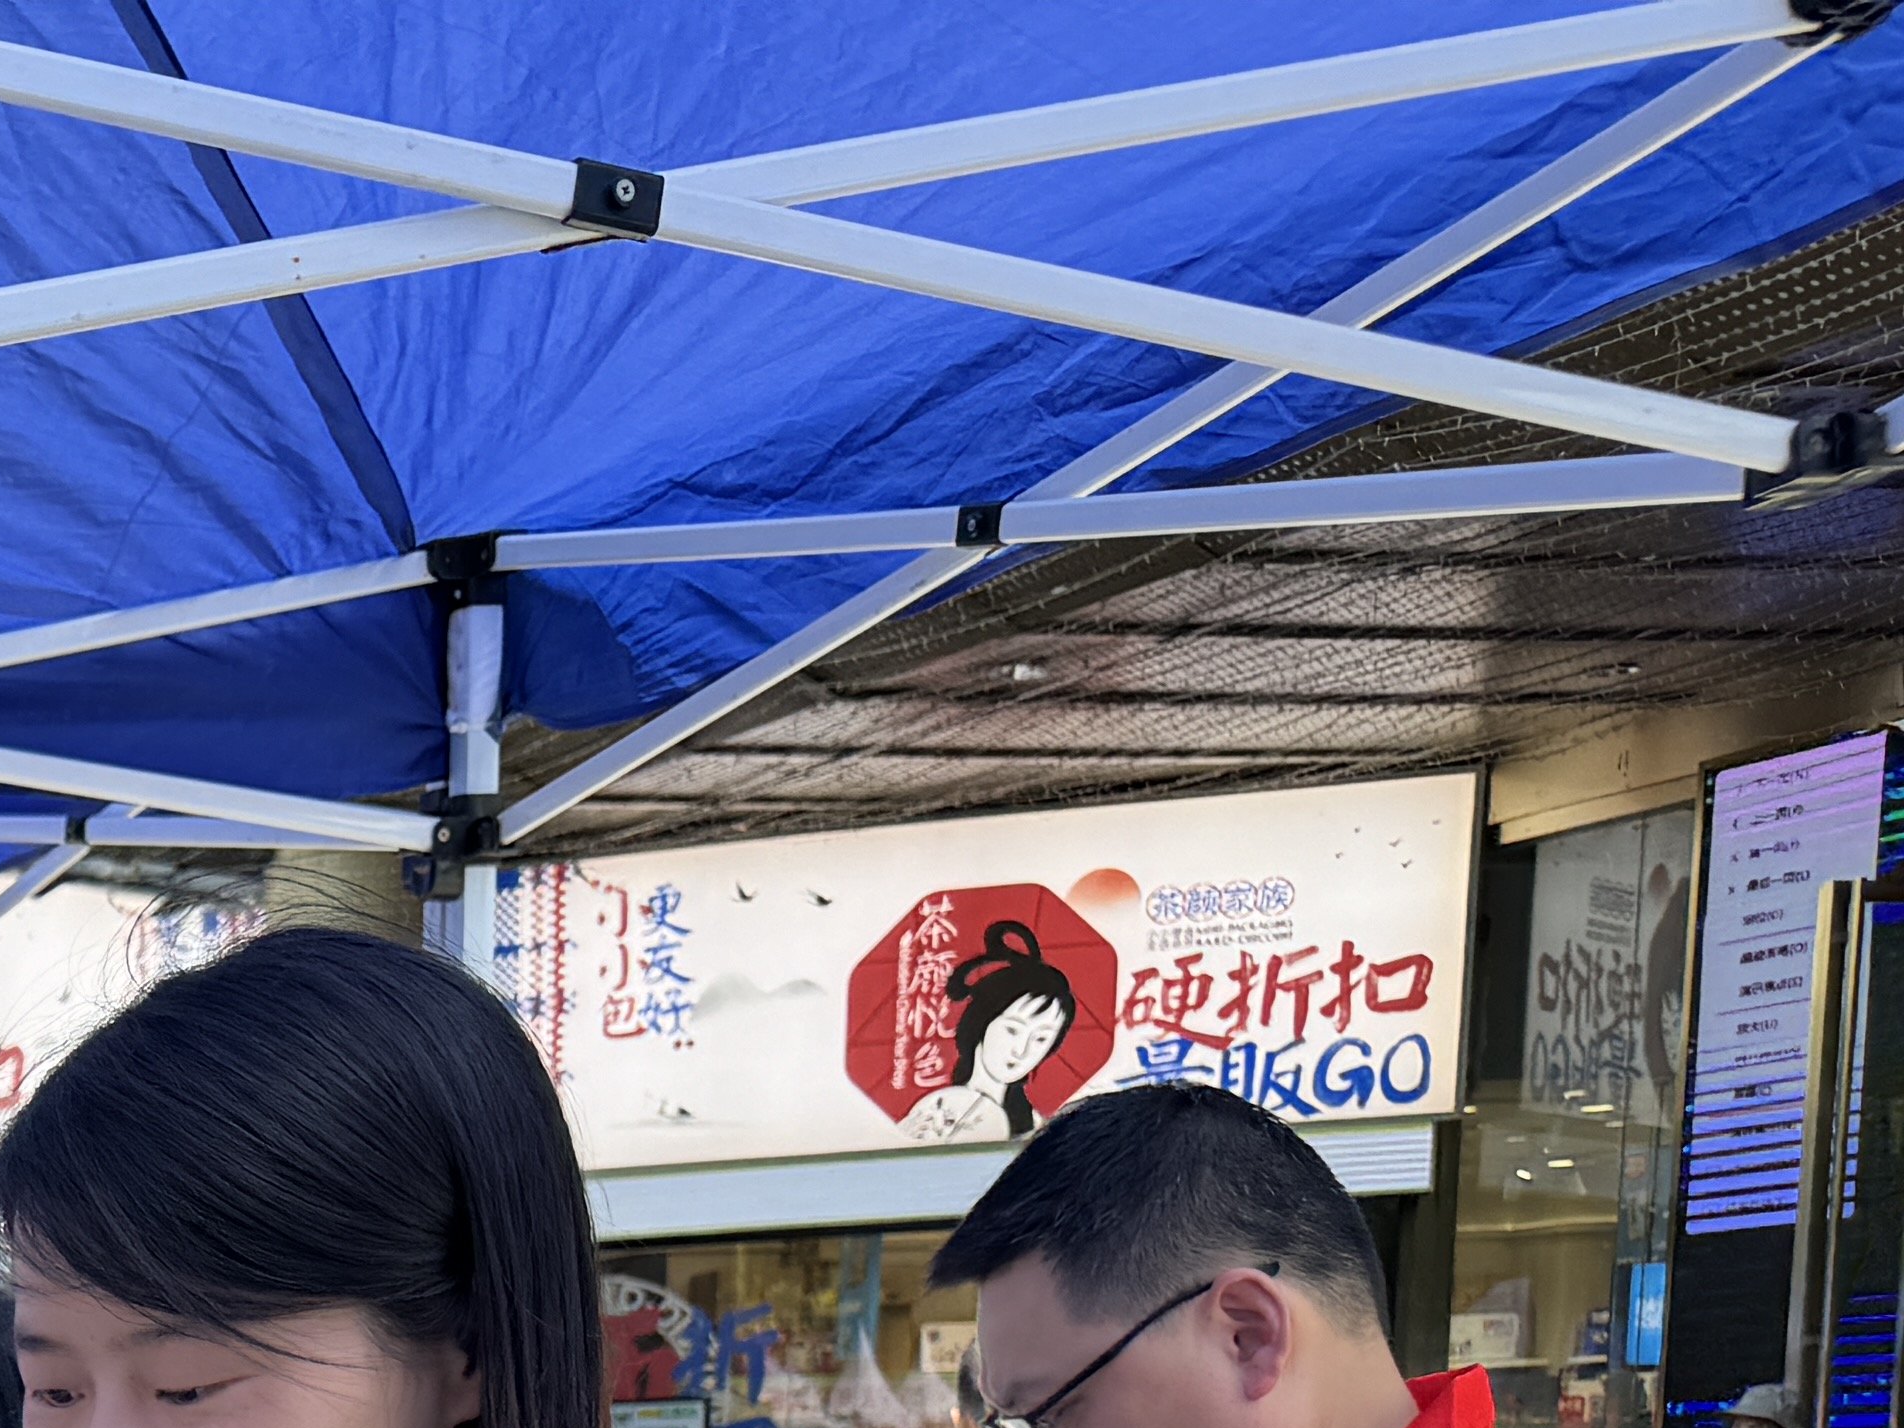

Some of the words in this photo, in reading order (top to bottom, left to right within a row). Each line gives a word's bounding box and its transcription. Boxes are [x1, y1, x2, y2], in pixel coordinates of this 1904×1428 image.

[638, 883, 694, 1036] 更友好
[910, 895, 958, 1088] 茶颜悦色
[1118, 940, 1434, 1050] 硬折扣
